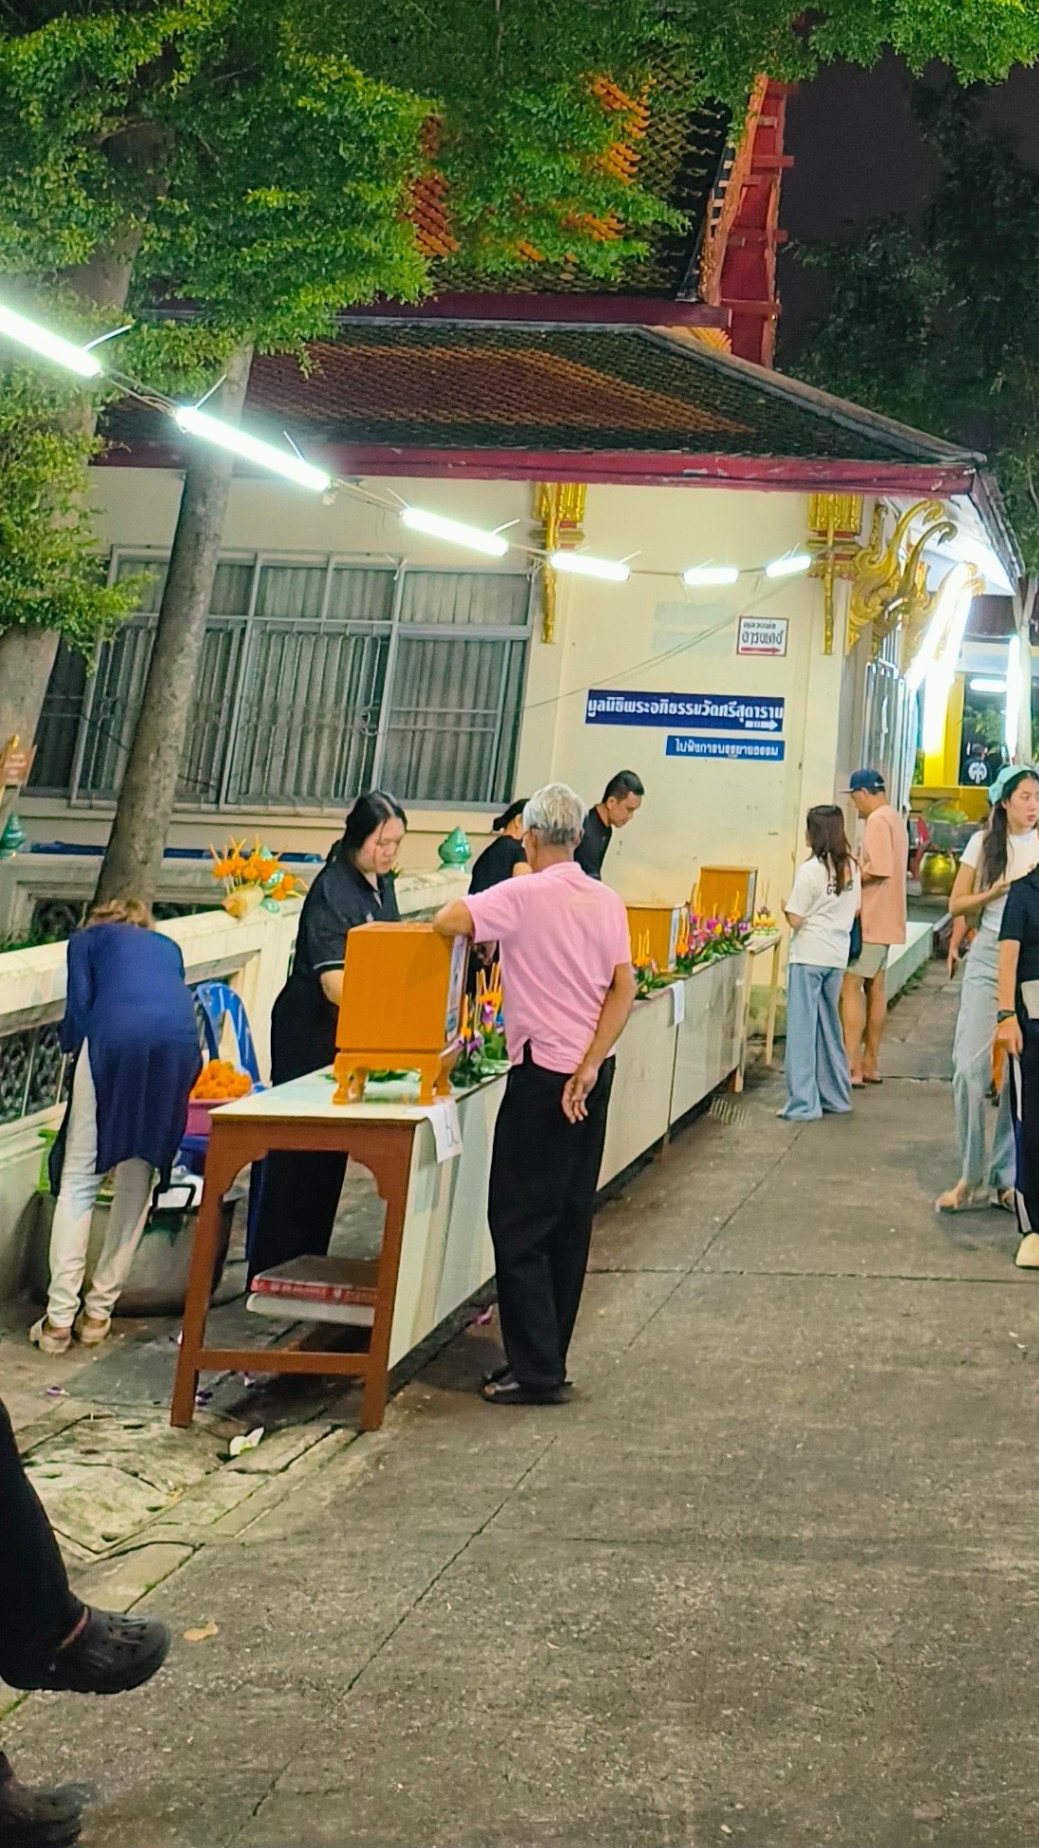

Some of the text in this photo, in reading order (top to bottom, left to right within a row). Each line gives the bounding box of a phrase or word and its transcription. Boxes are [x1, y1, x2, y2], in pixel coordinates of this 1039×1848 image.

[587, 696, 783, 723] มูลนิธิพระอภิธรรมวัดศรีสุดาราม
